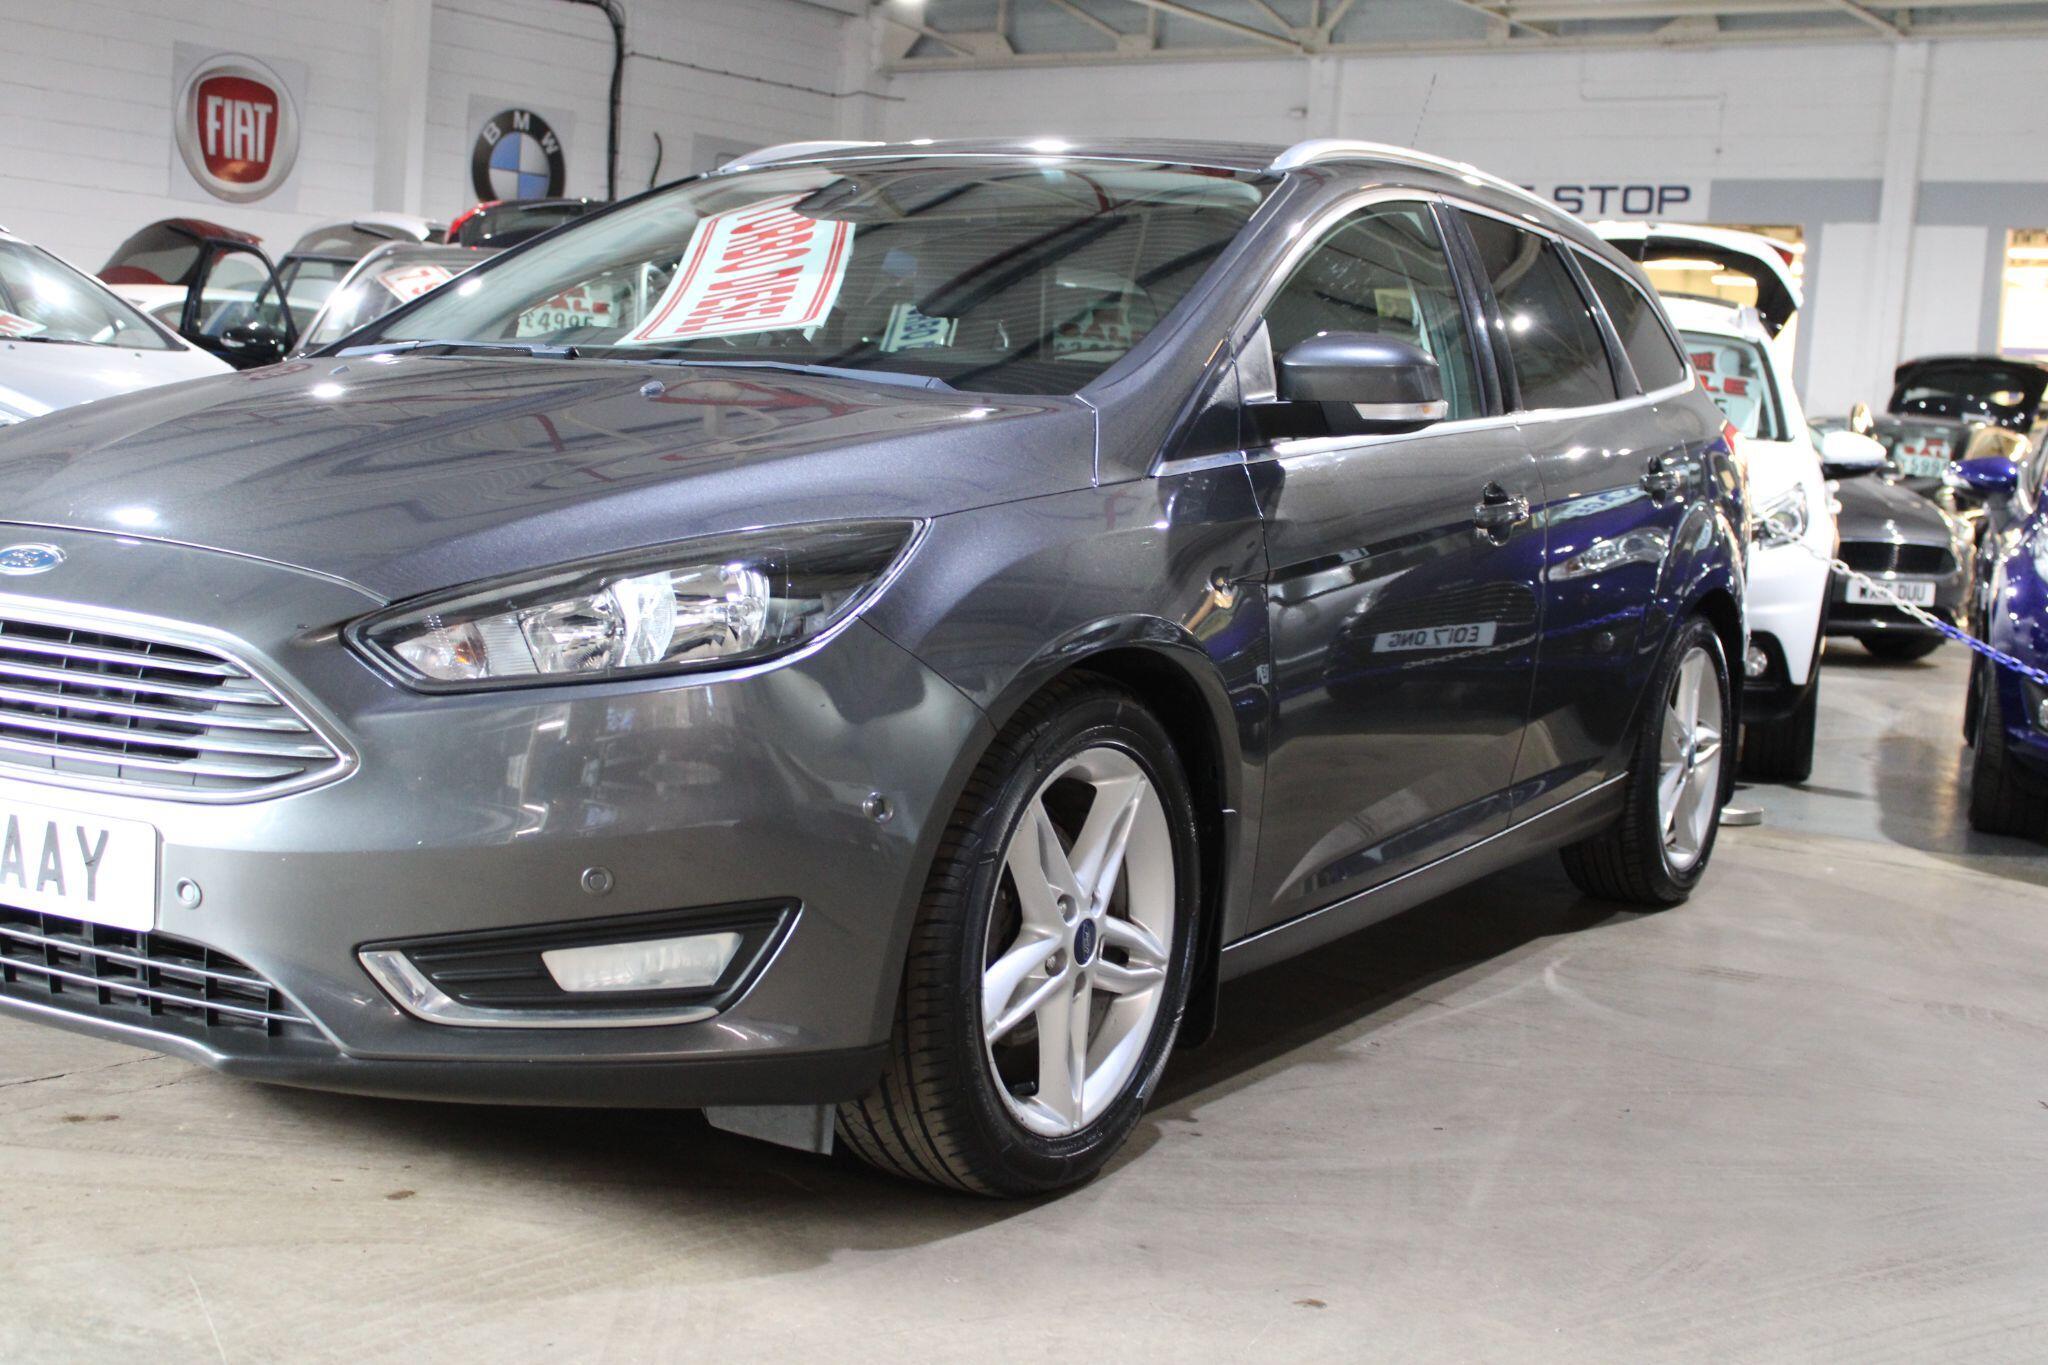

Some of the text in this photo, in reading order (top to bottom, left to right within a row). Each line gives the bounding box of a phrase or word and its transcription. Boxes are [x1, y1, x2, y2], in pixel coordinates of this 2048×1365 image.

[206, 95, 272, 163] FIAT
[483, 111, 559, 155] BMW
[1553, 185, 1691, 215] STOP
[675, 265, 804, 333] DIESEL
[0, 814, 109, 901] AAY
